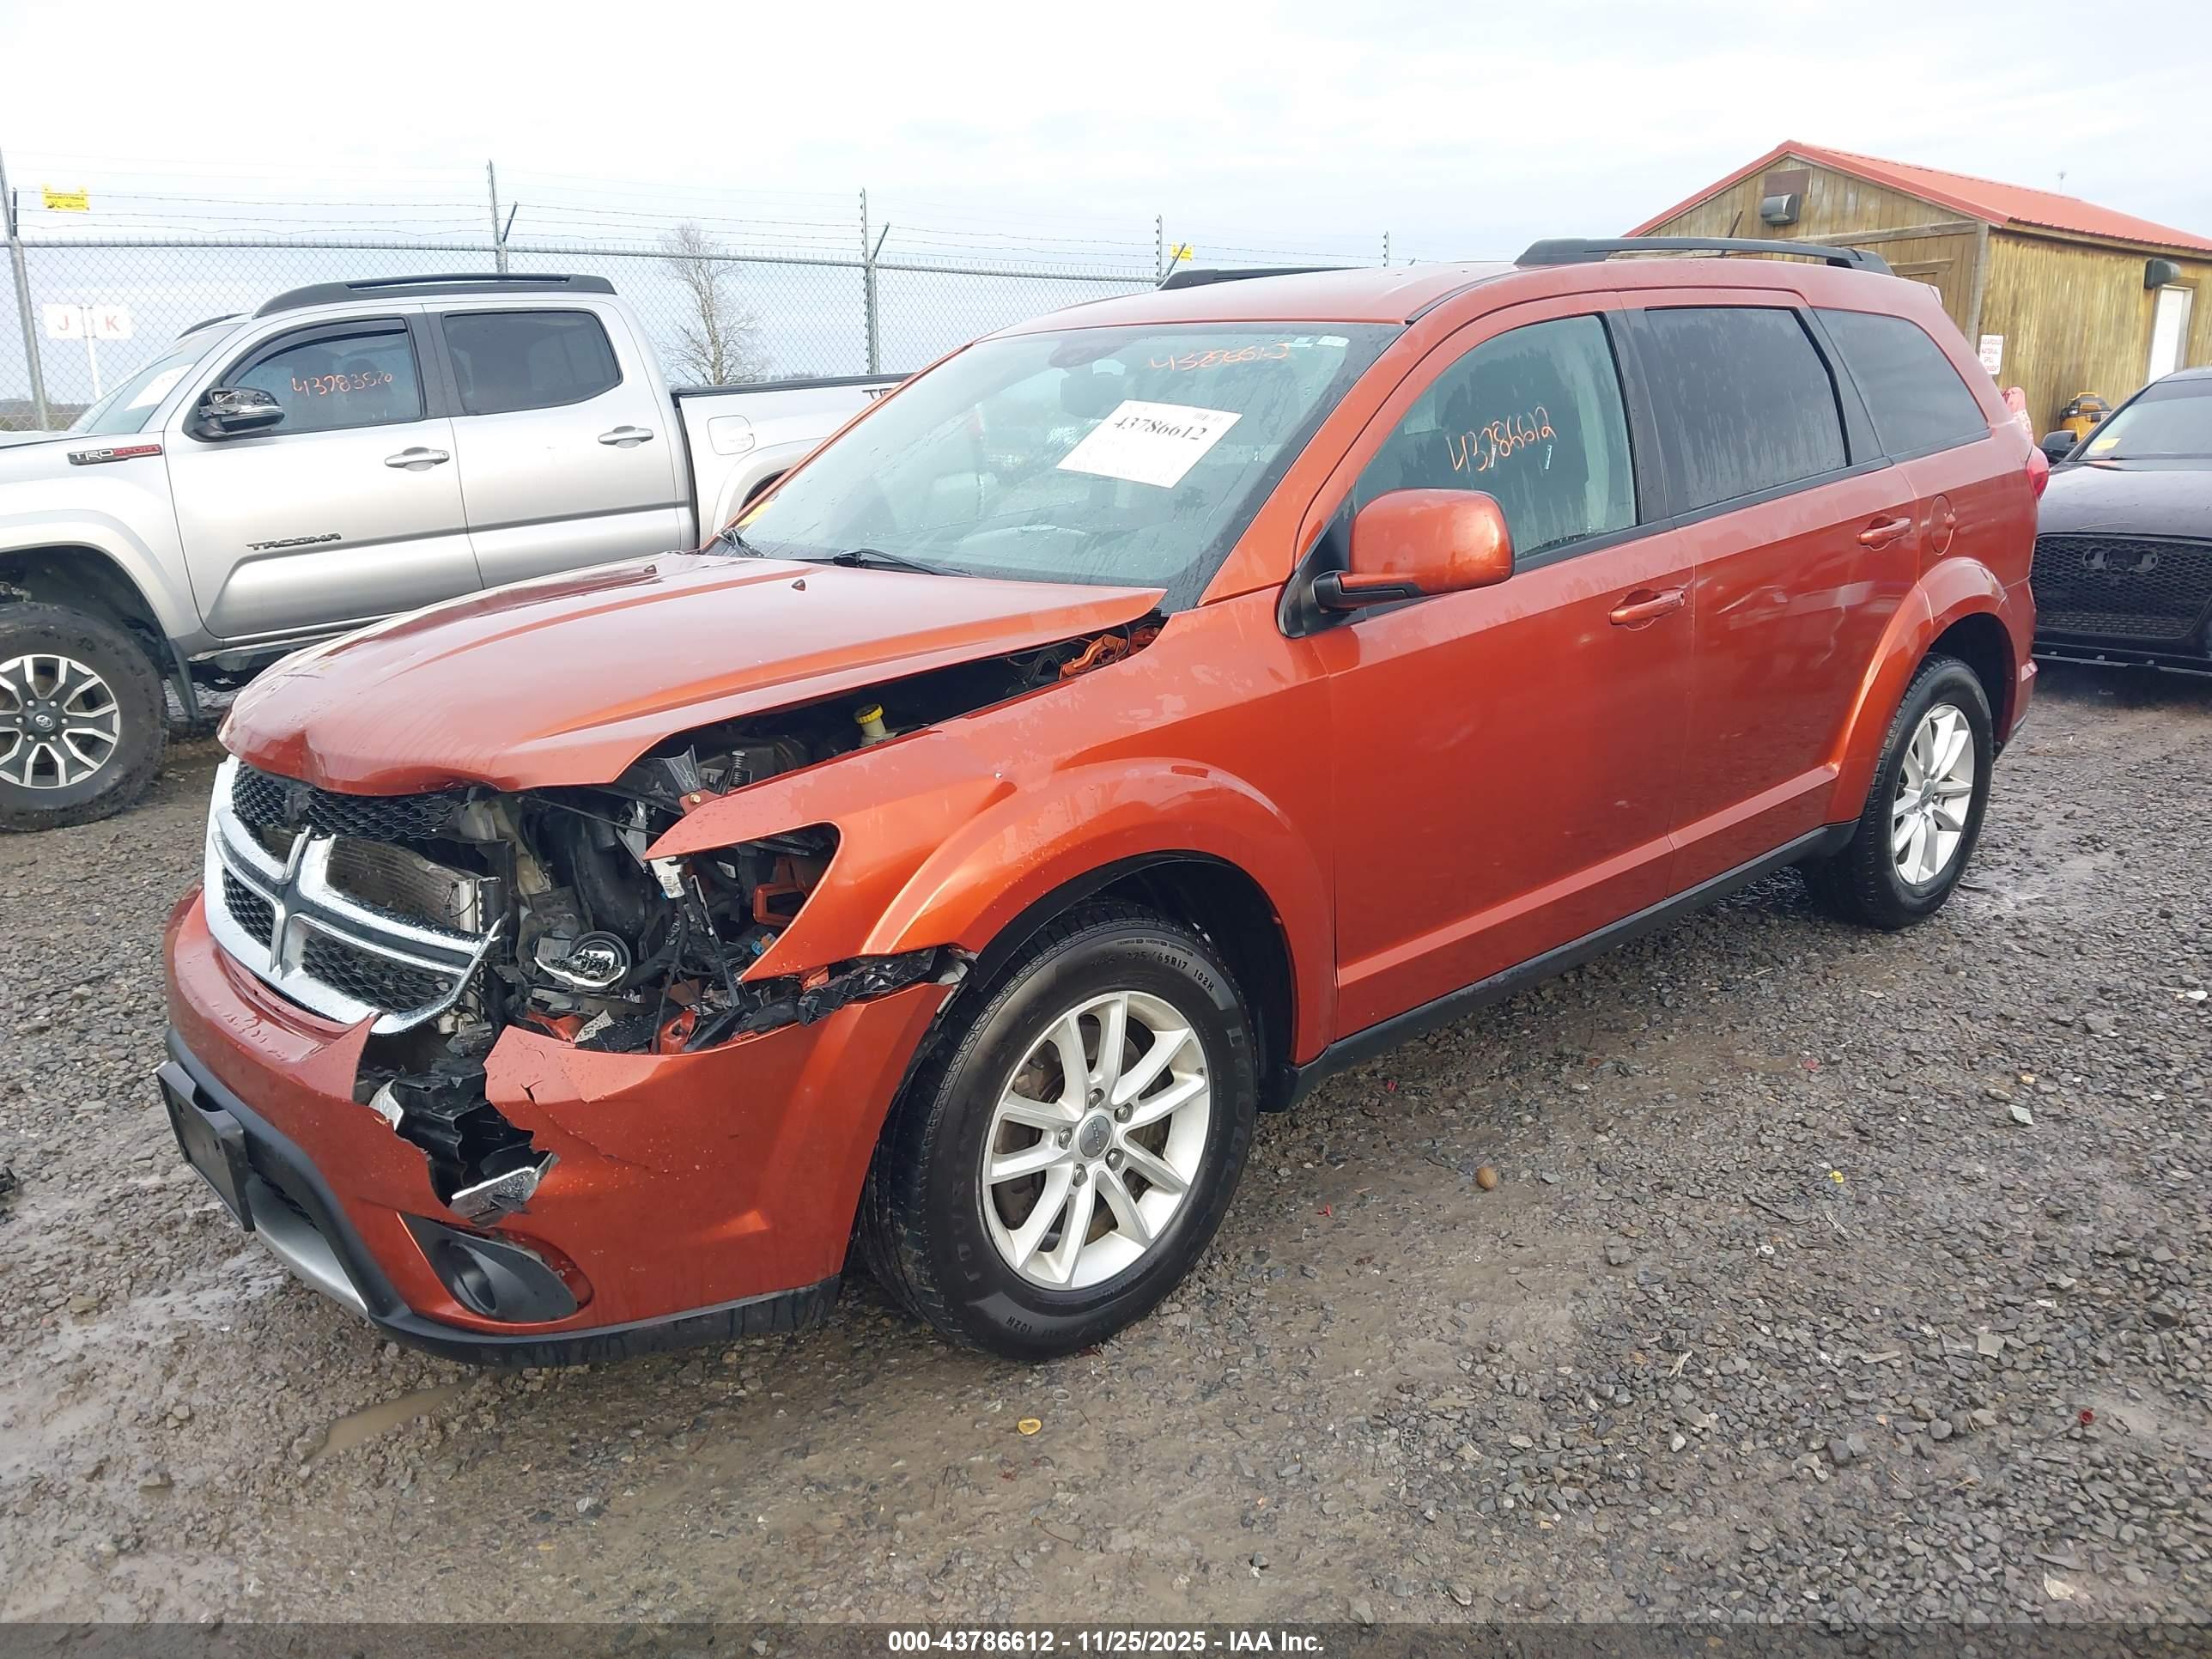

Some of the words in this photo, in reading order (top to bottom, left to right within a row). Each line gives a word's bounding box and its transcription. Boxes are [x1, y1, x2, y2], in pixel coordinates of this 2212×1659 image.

[58, 315, 70, 331] J
[105, 315, 120, 331] K
[1114, 416, 1208, 441] 43786612
[70, 448, 113, 461] TRD
[113, 445, 160, 457] SPORT
[246, 532, 342, 550] TACOMA
[1194, 969, 1215, 992] 102H
